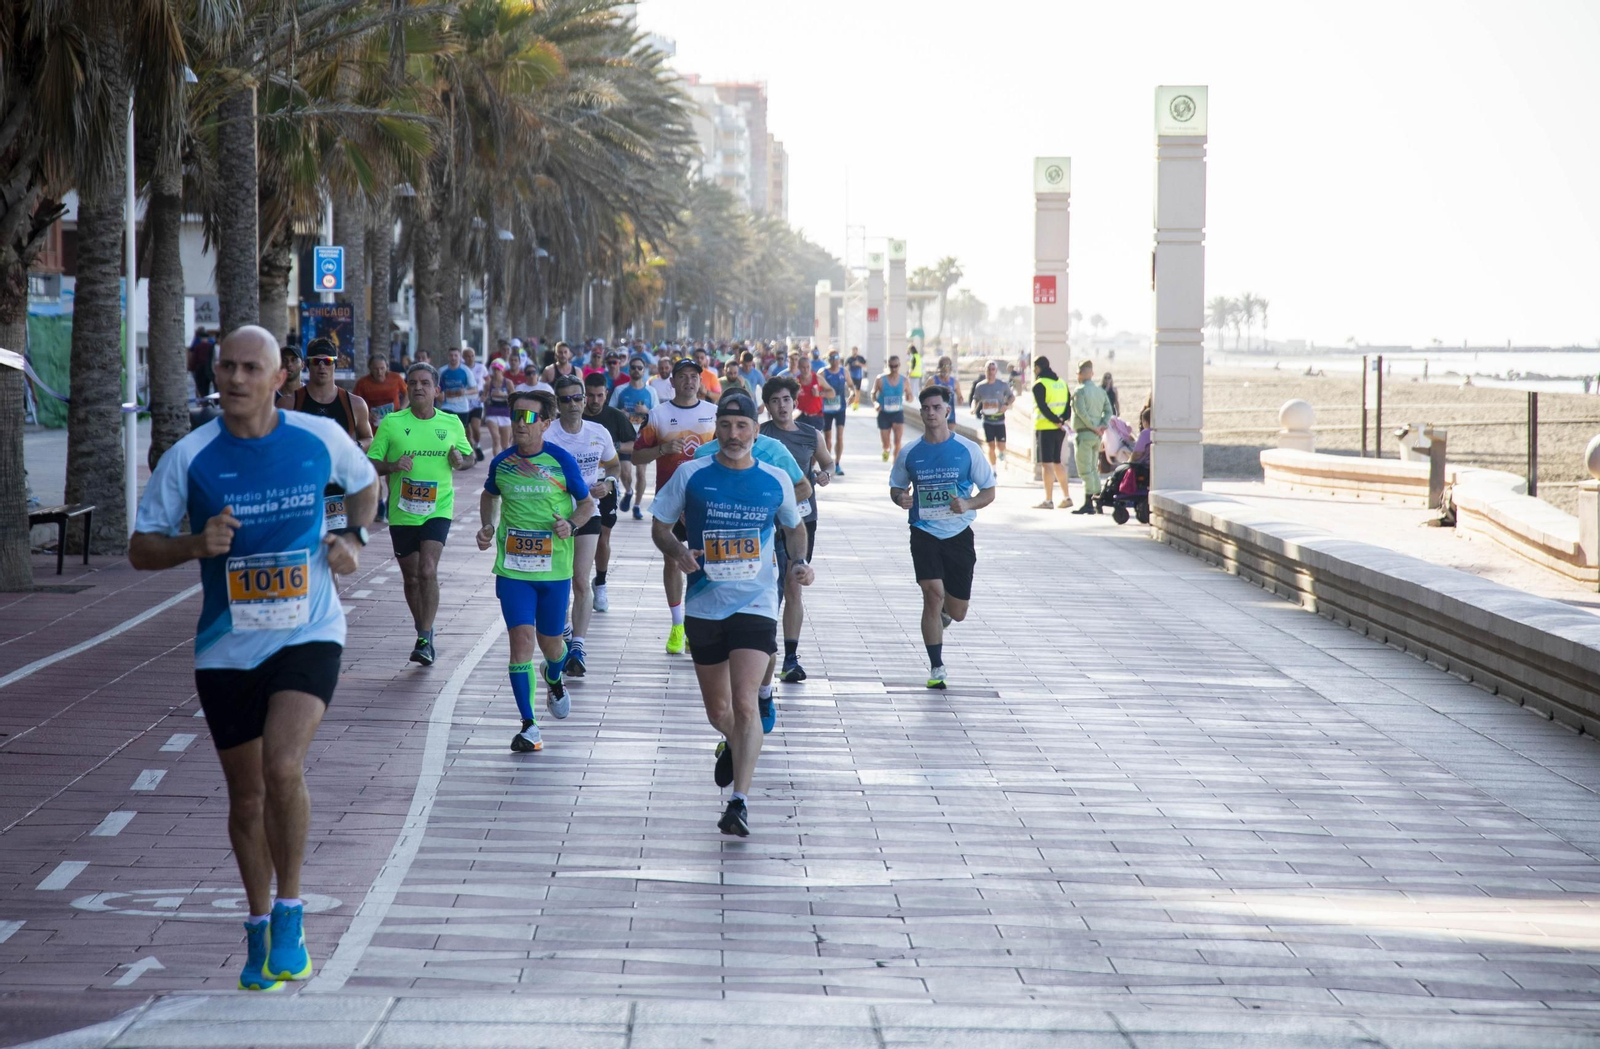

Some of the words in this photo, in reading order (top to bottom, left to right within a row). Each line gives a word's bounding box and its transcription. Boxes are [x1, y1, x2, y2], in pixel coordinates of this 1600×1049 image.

[309, 307, 351, 317] CHICAGO
[224, 492, 262, 504] Medio
[266, 483, 316, 499] Maratón
[407, 486, 430, 498] 442
[514, 484, 552, 493] SAKATA
[280, 493, 316, 510] 2025
[926, 490, 950, 502] 448
[706, 501, 732, 510] Medio
[734, 503, 769, 513] Maratón
[706, 508, 741, 519] Almería
[742, 511, 768, 521] 2025
[516, 538, 544, 551] 395
[712, 538, 755, 556] 1118
[238, 566, 304, 592] 1016
